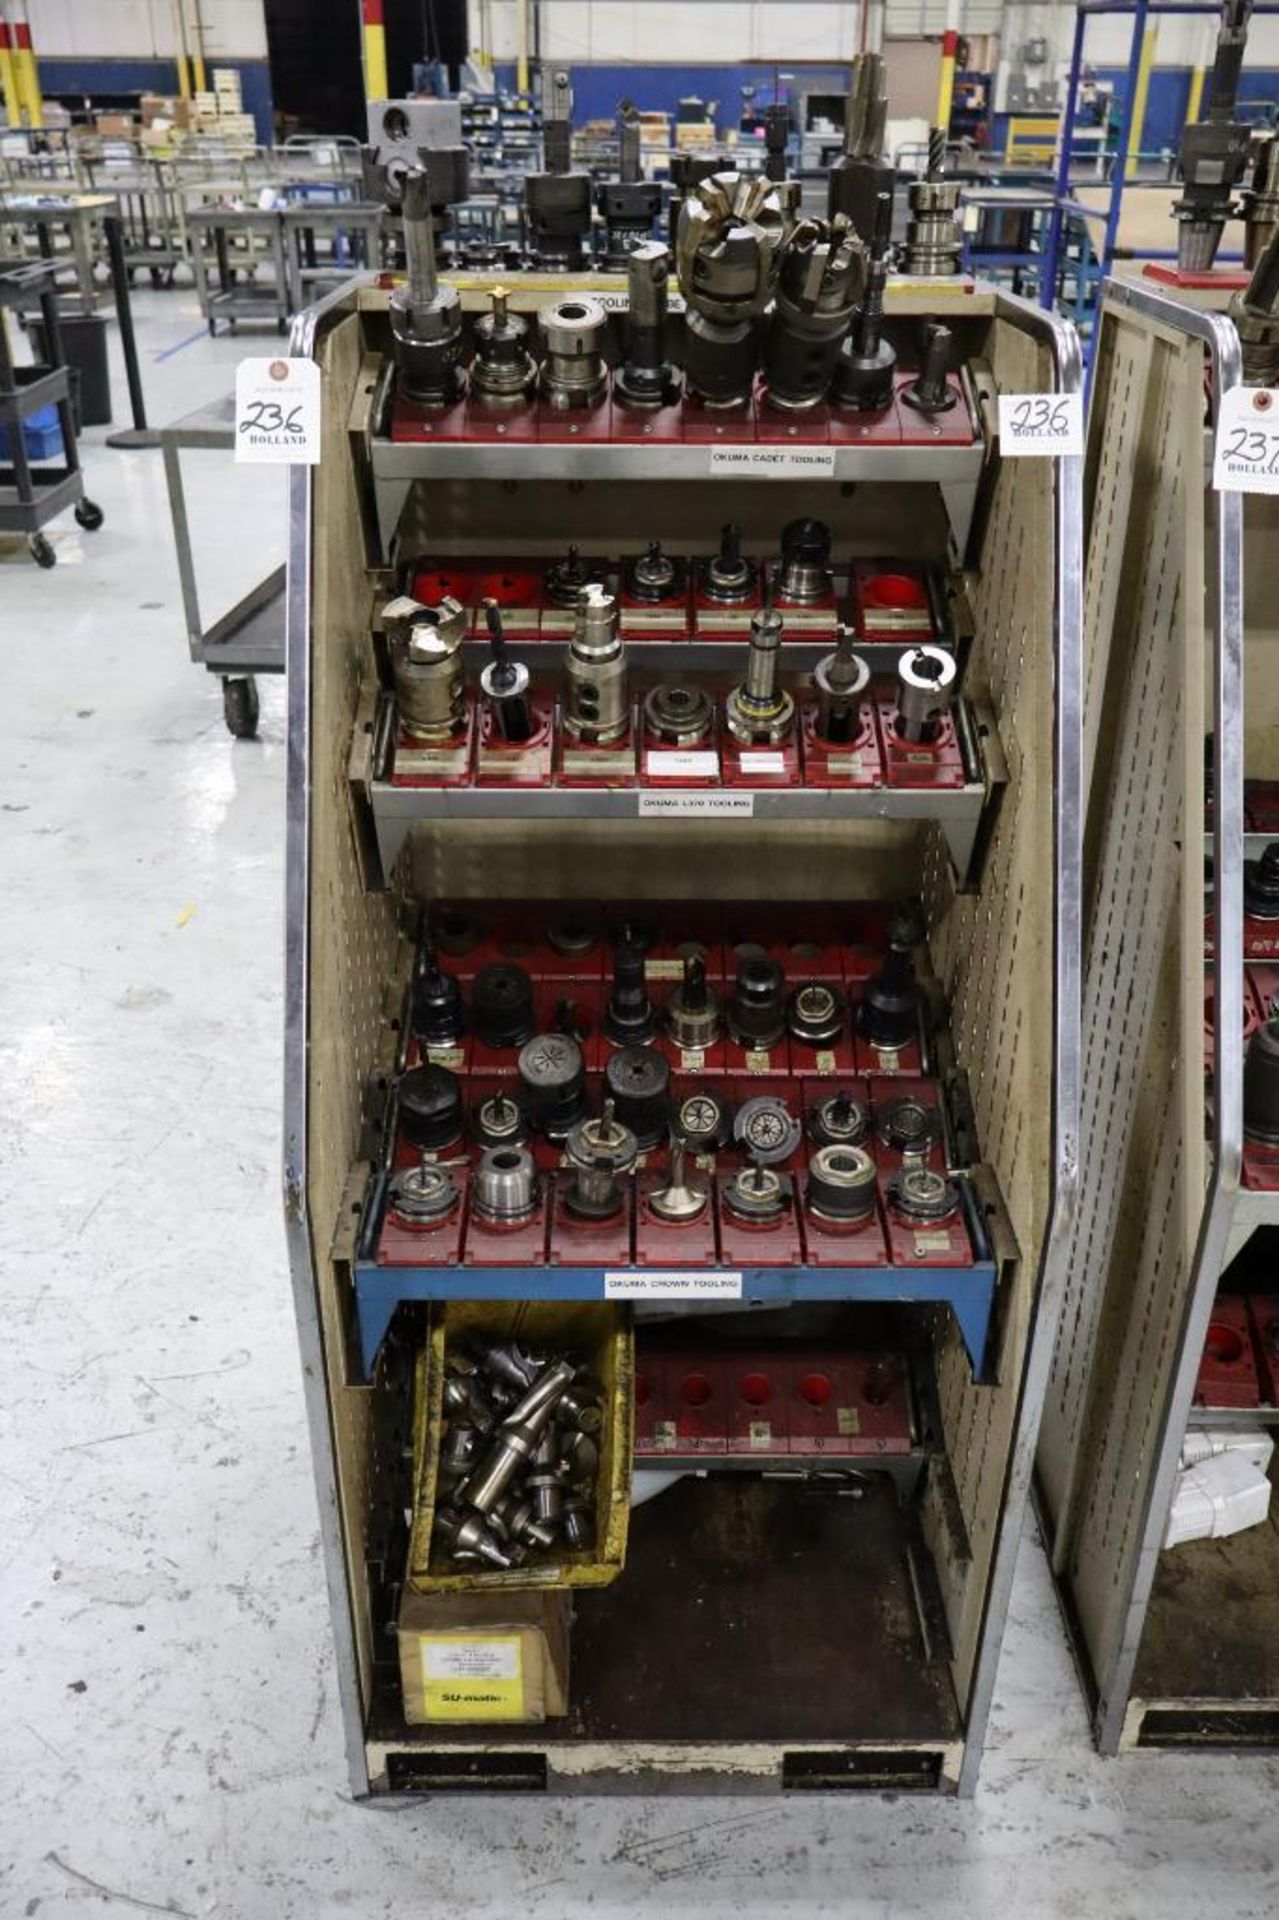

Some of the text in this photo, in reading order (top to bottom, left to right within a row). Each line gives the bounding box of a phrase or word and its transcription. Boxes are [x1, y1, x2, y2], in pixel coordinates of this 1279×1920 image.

[240, 401, 304, 434] 236
[1010, 398, 1070, 432] 236
[250, 435, 307, 446] HOLLAND
